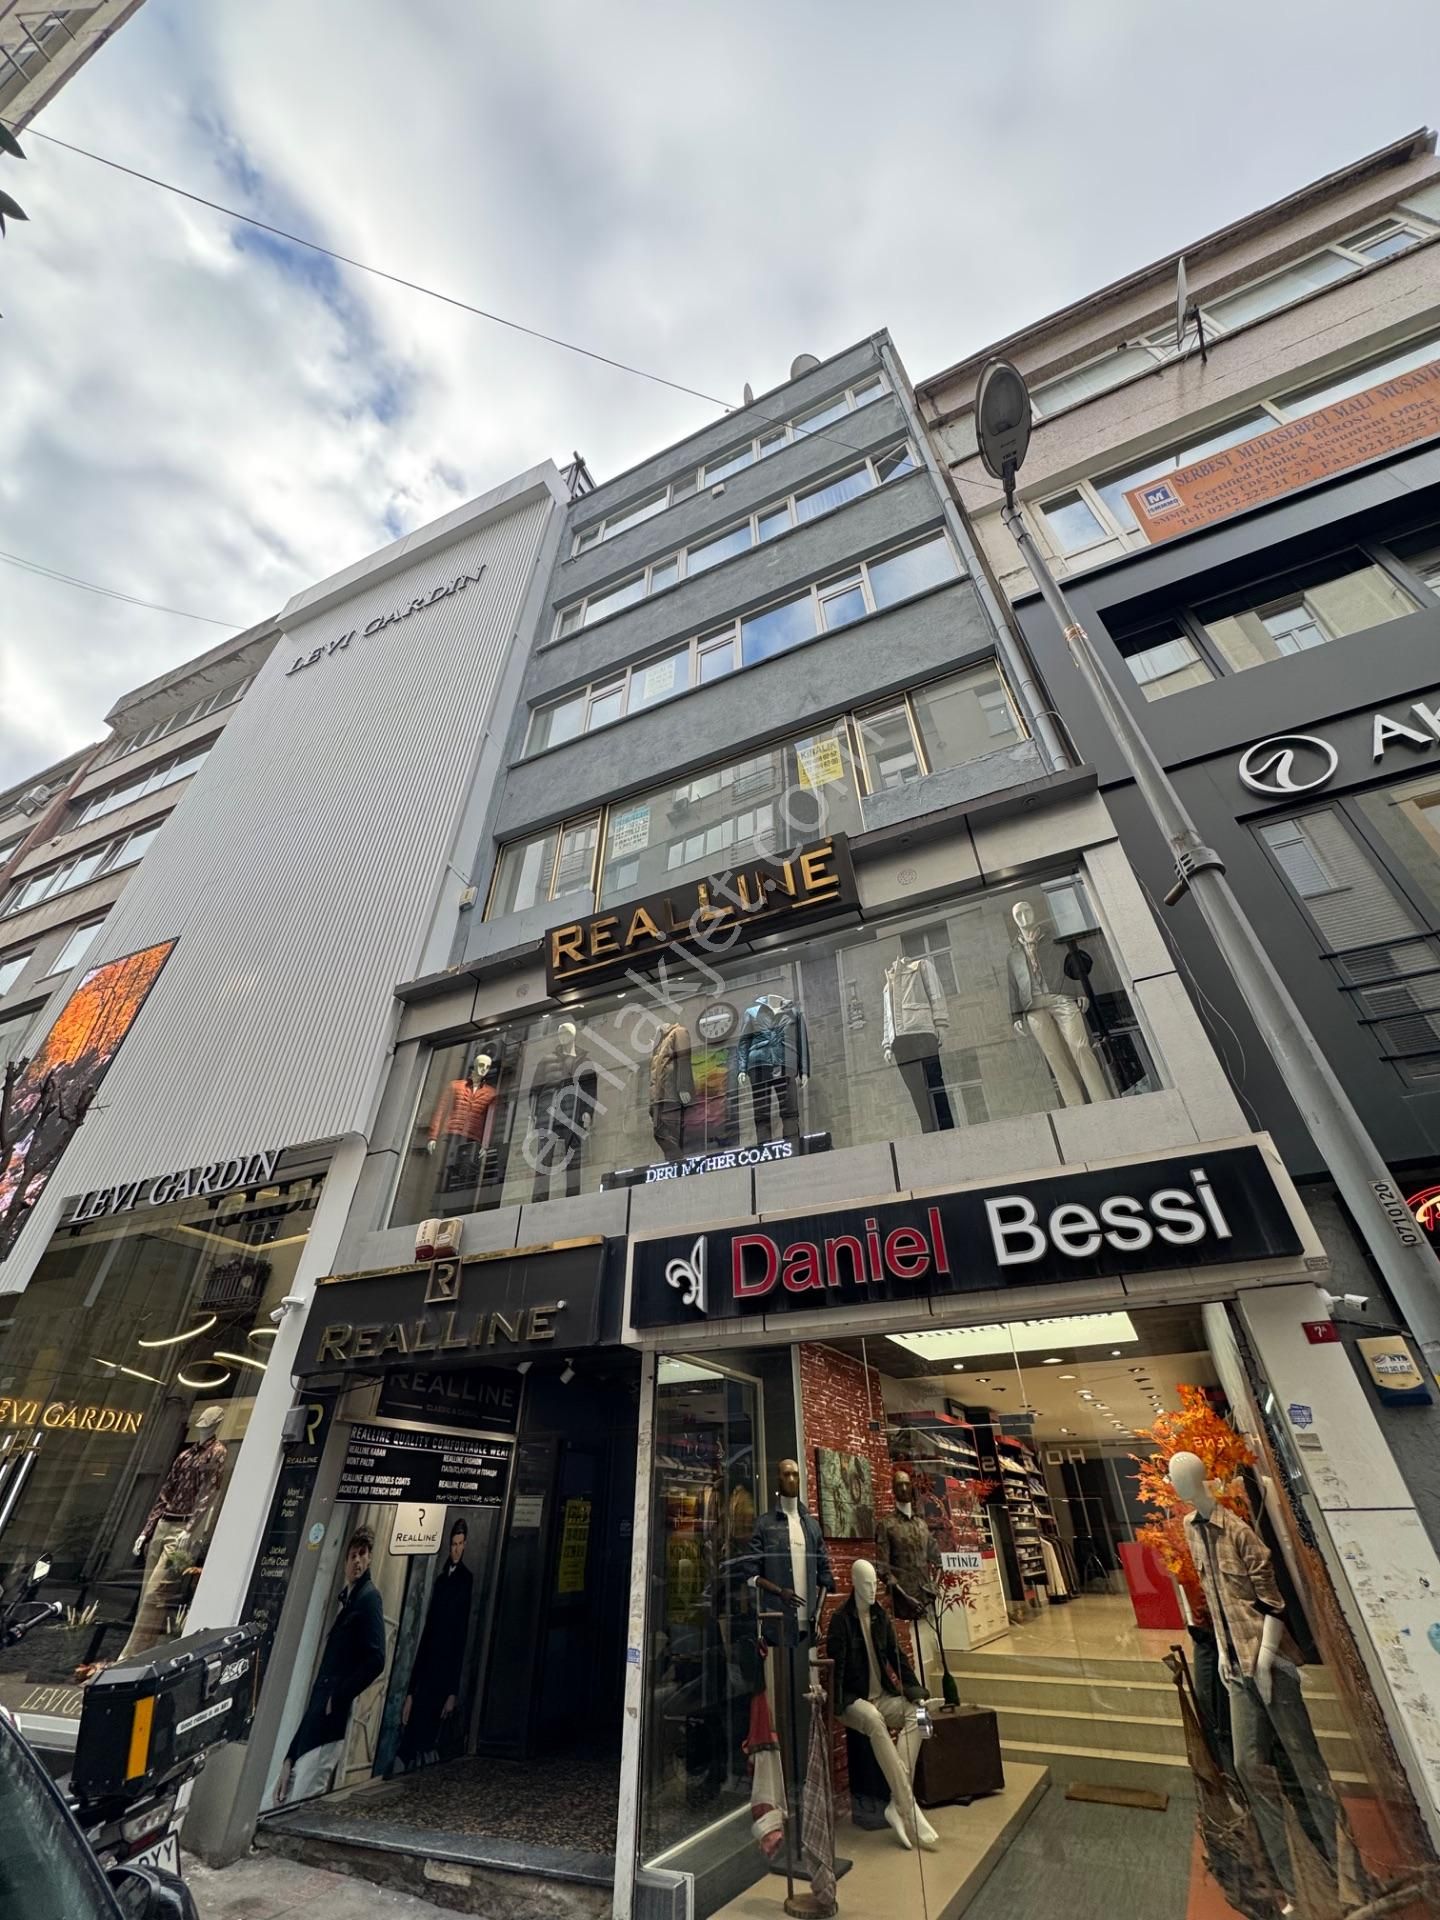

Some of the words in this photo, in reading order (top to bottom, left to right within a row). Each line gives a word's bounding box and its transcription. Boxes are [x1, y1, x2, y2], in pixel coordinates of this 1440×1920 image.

[1175, 454, 1233, 487] SERBEST
[1194, 471, 1252, 501] Certified
[1255, 453, 1298, 479] Public
[1307, 417, 1386, 457] Accountant
[1390, 398, 1435, 419] Office
[285, 629, 356, 676] LEVI
[363, 564, 487, 638] GARDIN
[552, 845, 841, 968] REALLINE
[738, 1143, 793, 1166] COATS
[68, 1179, 148, 1223] LEVI
[149, 1148, 284, 1206] GARDIN
[731, 1206, 952, 1299] Daniel
[983, 1168, 1233, 1267] Bessi
[315, 1306, 560, 1362] REALLINE
[390, 1372, 514, 1408] REALLINE
[43, 1402, 143, 1434] GARDIN
[350, 1426, 391, 1443] REALLINE
[393, 1432, 430, 1448] QUALITY
[20, 1687, 71, 1712] LEVI
